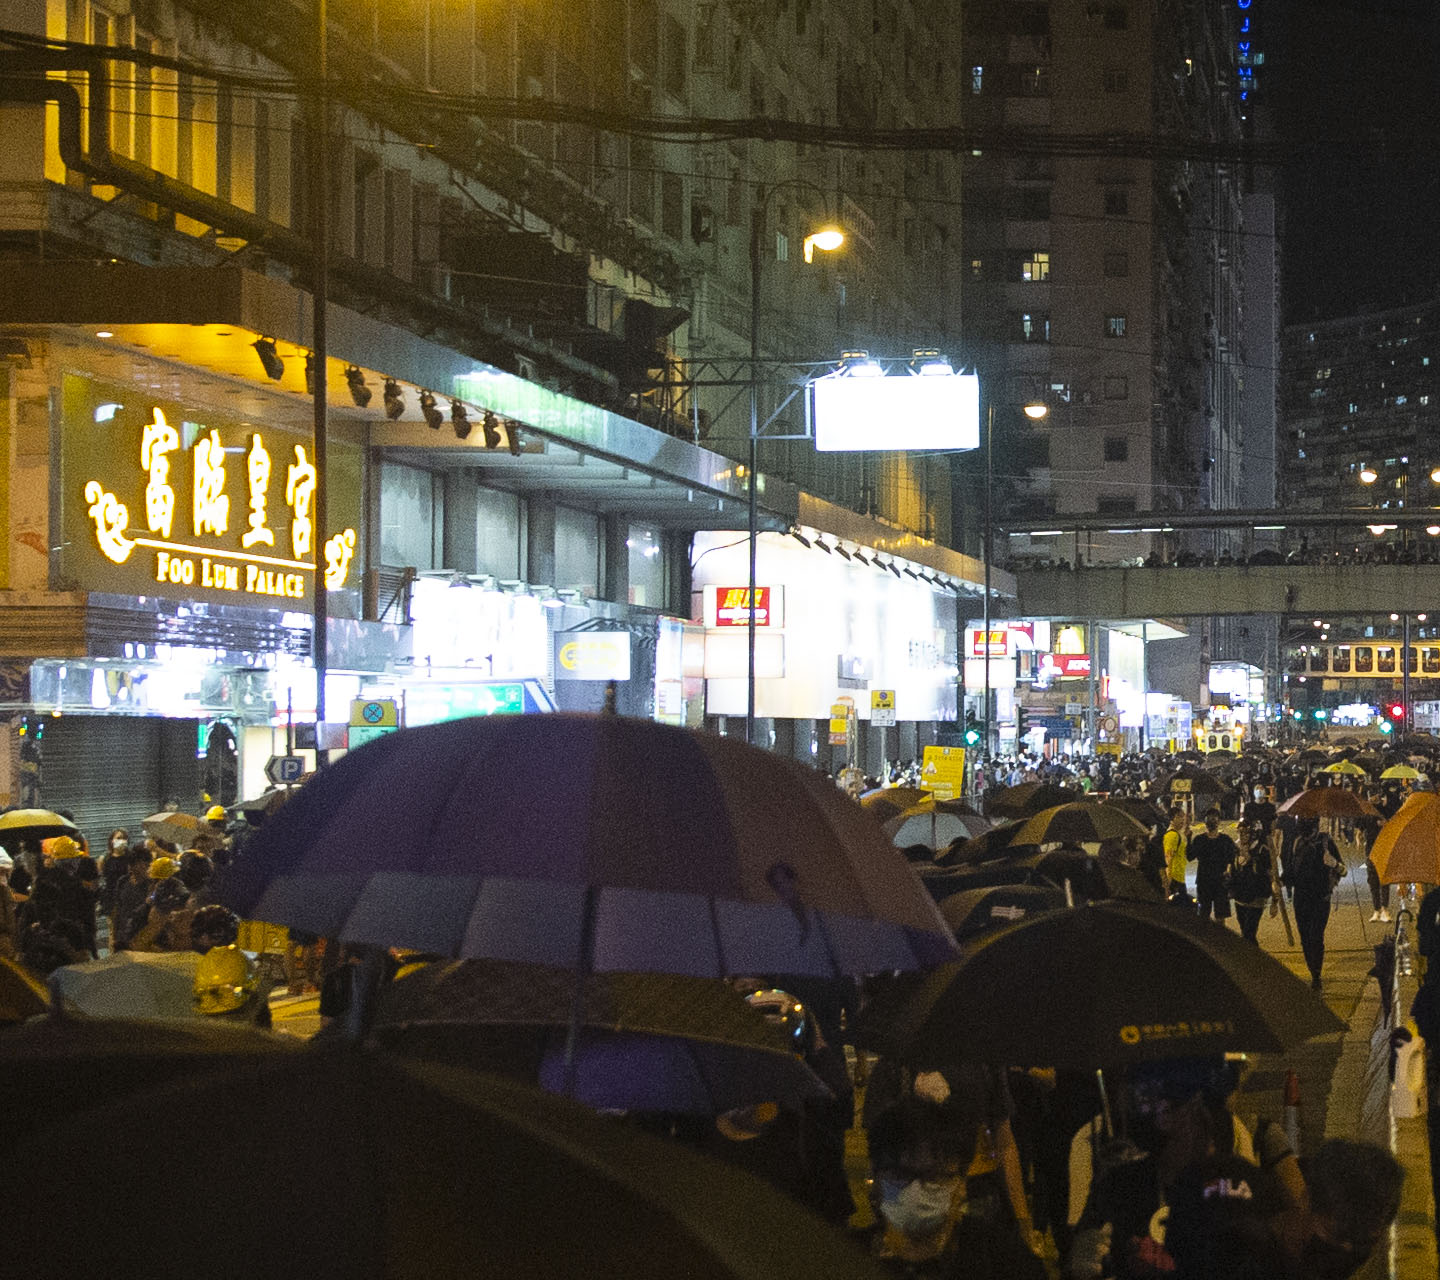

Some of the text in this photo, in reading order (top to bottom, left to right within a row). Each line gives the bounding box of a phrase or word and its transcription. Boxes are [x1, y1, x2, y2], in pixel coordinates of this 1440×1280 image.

[157, 552, 304, 598] FOO LUM PALACE
[1202, 1176, 1254, 1201] FILA
